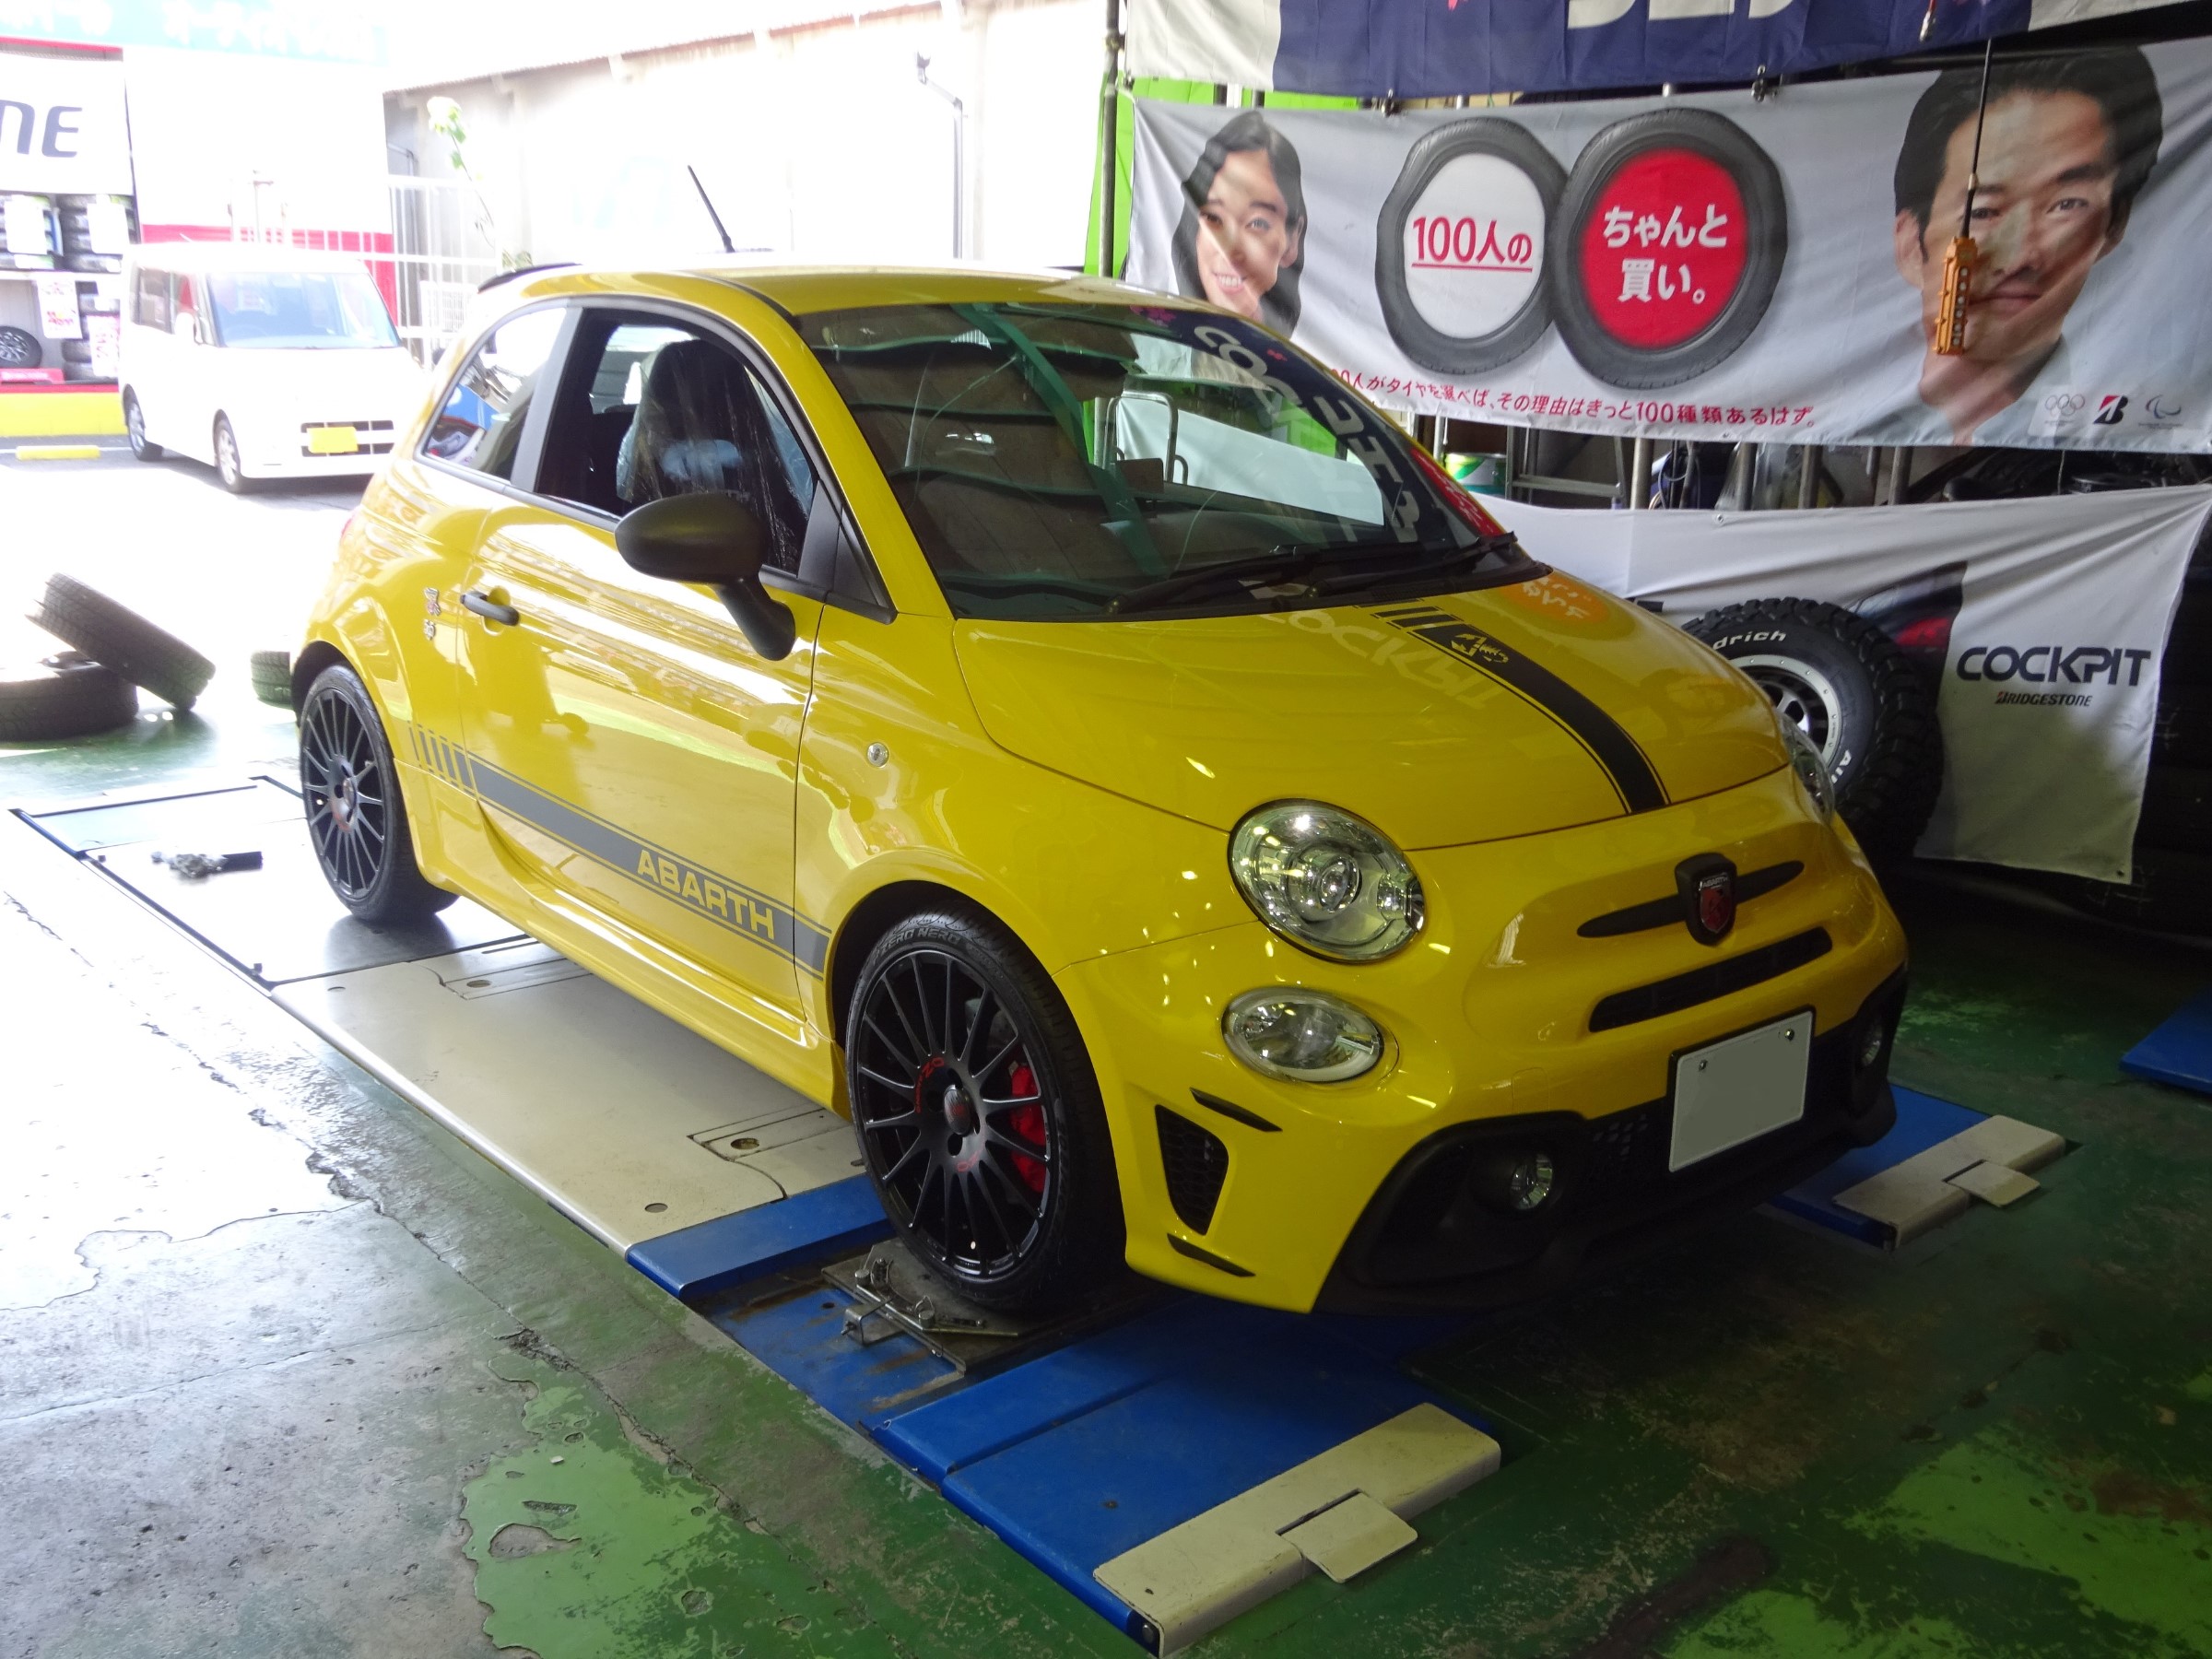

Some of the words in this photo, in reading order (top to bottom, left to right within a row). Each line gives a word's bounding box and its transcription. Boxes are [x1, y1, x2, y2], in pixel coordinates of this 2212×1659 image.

[1413, 216, 1533, 265] 100人の
[1603, 203, 1728, 248] ちゃんと
[1617, 258, 1706, 305] 買い。
[1331, 368, 1815, 428] 0人がタイヤを選べば、その理由はきっと100種類あるはず。
[1956, 645, 2152, 687] COCKPIT
[1994, 691, 2093, 708] BRIDGESTONE
[637, 849, 775, 940] ABARTH
[881, 928, 915, 956] ZERO
[917, 926, 961, 945] NERO
